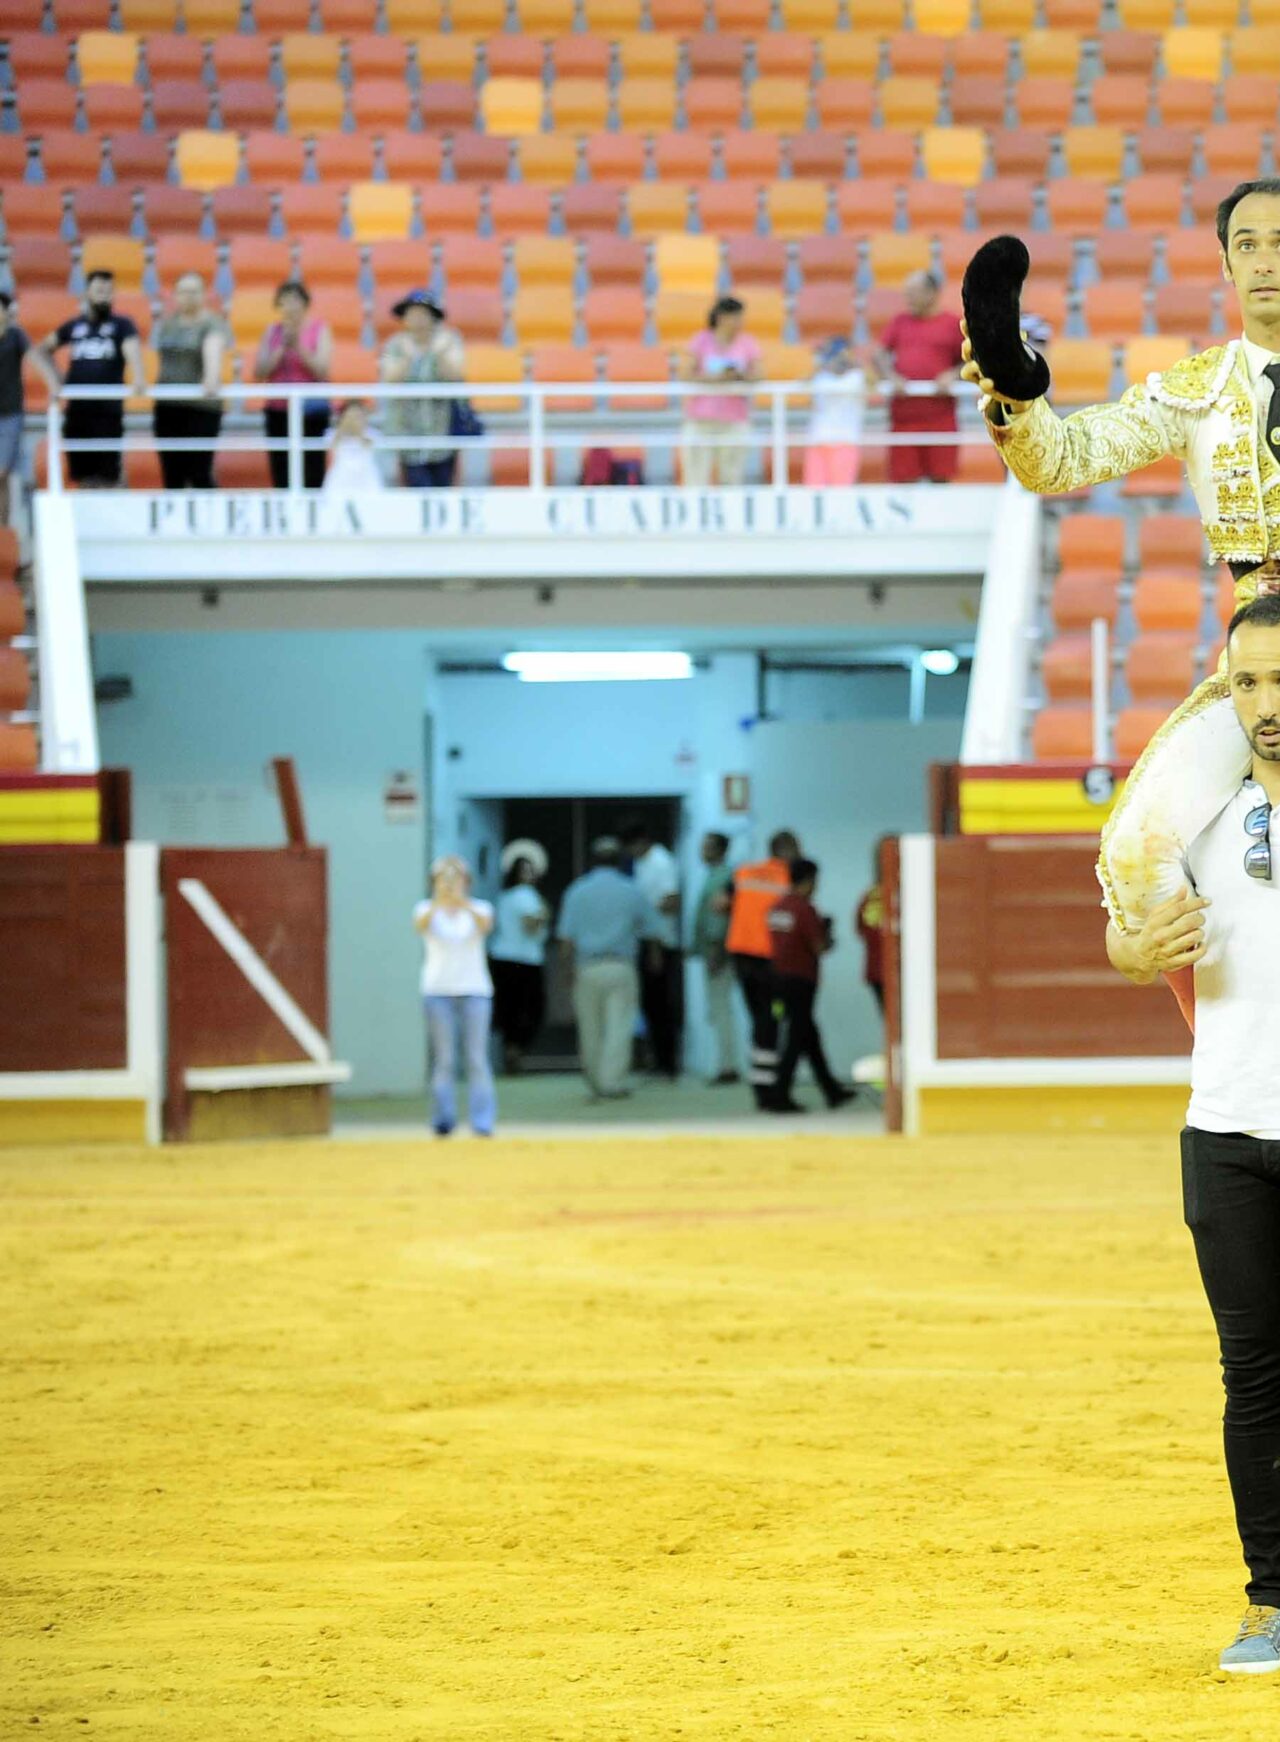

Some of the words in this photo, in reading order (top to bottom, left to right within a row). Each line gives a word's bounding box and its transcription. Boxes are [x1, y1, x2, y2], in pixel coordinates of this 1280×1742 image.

[148, 498, 364, 535] PUERTA
[419, 497, 487, 534] DE
[547, 494, 915, 532] CUADRILLAS
